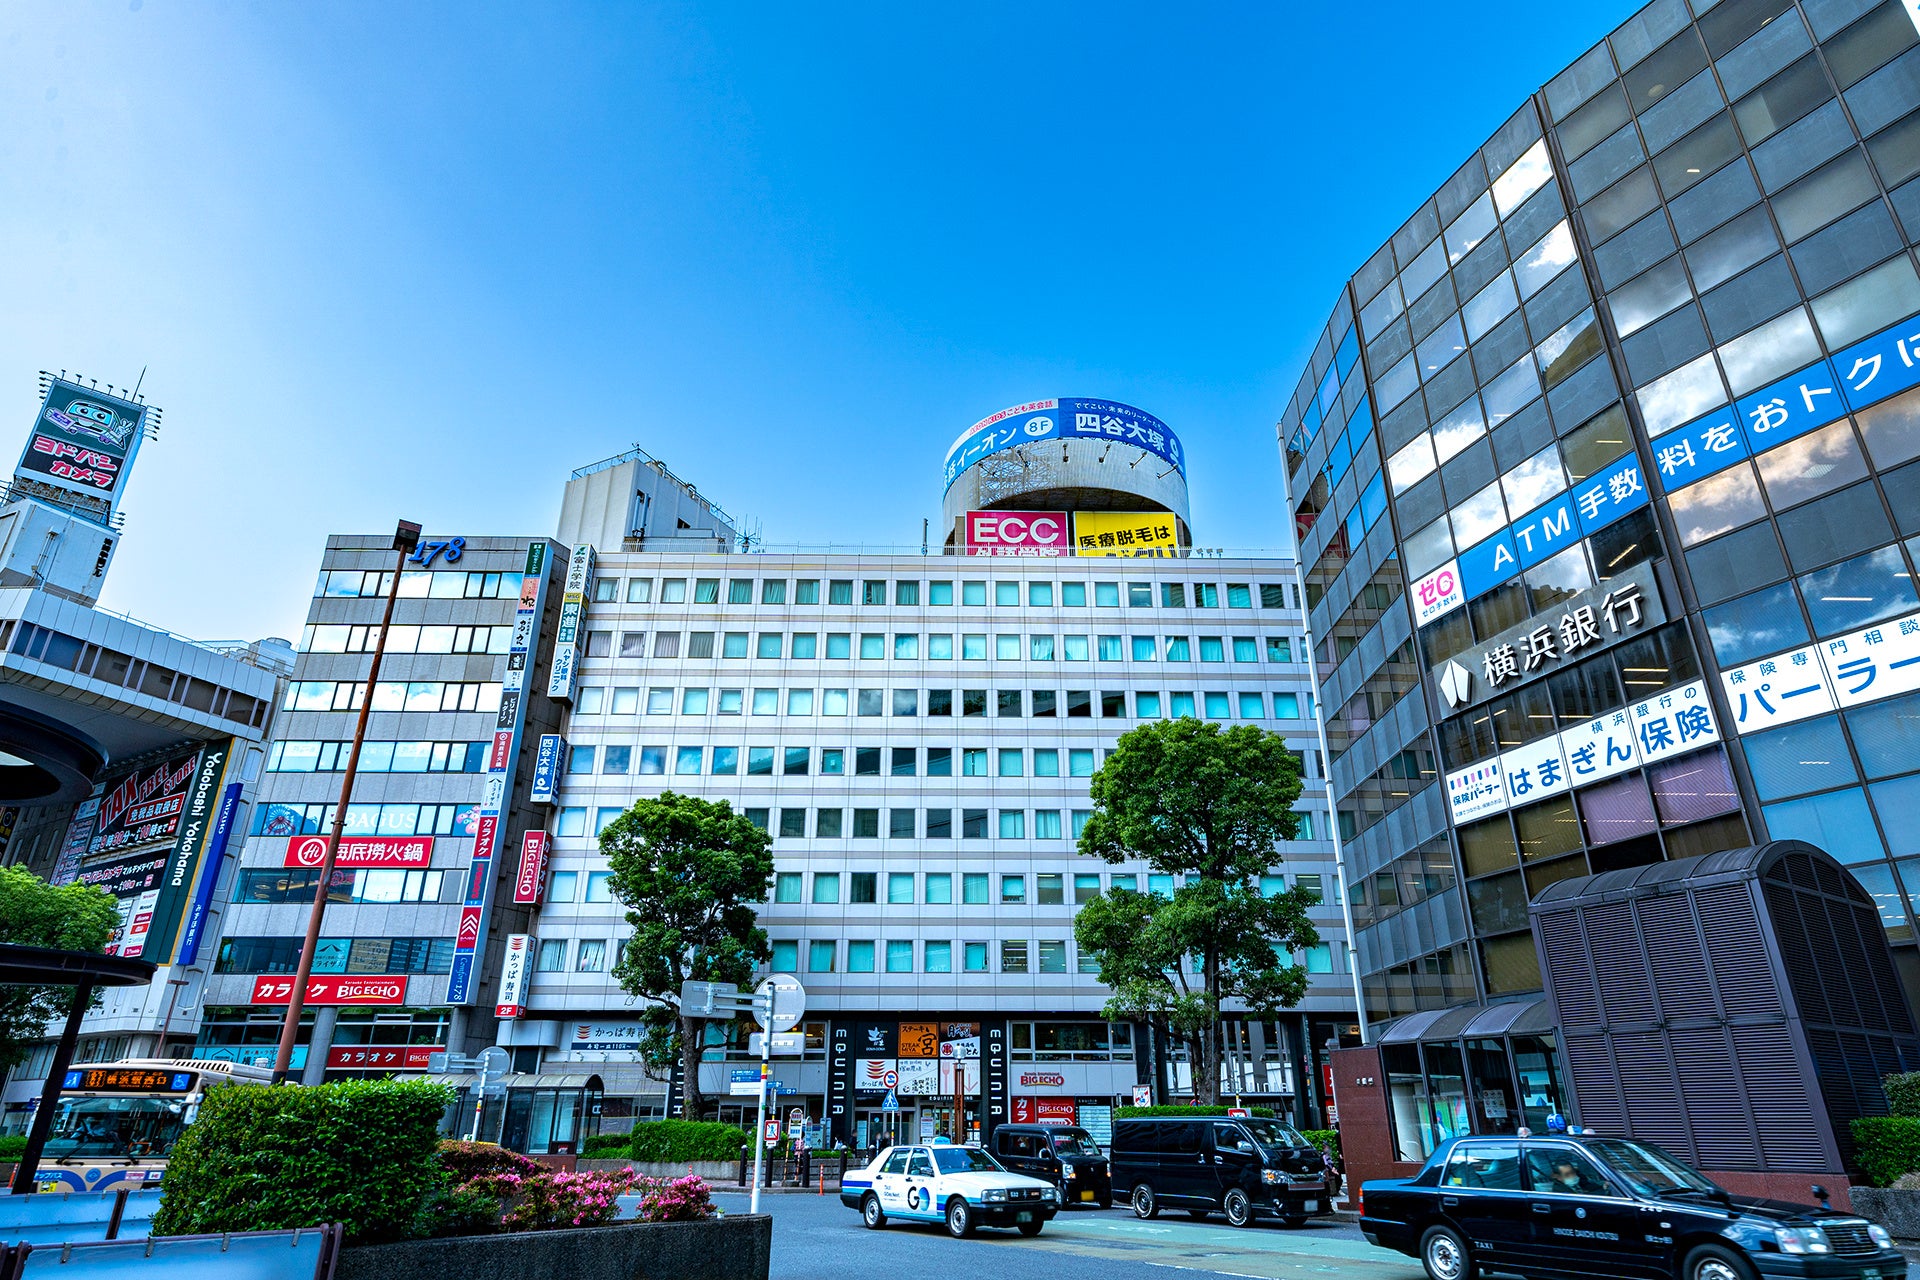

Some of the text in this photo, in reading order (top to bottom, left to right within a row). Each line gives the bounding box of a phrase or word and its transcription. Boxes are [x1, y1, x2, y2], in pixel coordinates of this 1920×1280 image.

[1029, 420, 1049, 433] 8F
[1076, 413, 1166, 453] 四谷大塚
[33, 436, 117, 472] ヨドバシ
[50, 460, 114, 487] カメラ
[974, 517, 1059, 544] ECC
[1079, 526, 1171, 550] 医療脱毛は
[408, 536, 466, 568] 178
[569, 556, 585, 590] 富士学院
[562, 603, 578, 628] 東進
[1482, 580, 1646, 688] 横浜銀行
[551, 659, 562, 691] クリニック
[560, 648, 571, 681] ハヤシ眼科
[507, 697, 517, 725] ビリヤード
[1590, 687, 1697, 735] 横浜銀行の
[537, 738, 554, 776] 四谷大塚
[163, 756, 196, 796] STORE
[99, 762, 170, 834] TAX FREE
[171, 752, 223, 887] Yodobashi Yokohama
[478, 819, 494, 855] カラオケ
[527, 839, 540, 861] BIG
[519, 864, 535, 896] ECHO
[257, 983, 328, 998] カラケ
[337, 985, 400, 998] BIG ECHO
[453, 985, 463, 1000] 178
[505, 953, 520, 1001] かっぱ寿司
[500, 1006, 513, 1015] 2F
[917, 1026, 938, 1056] 宮
[340, 1052, 396, 1063] カラオケ
[832, 1028, 848, 1115] EQUINIA
[990, 1029, 1003, 1115] EQUINIA
[1020, 1076, 1065, 1085] BIG ECHO
[1474, 1241, 1494, 1250] TAXI
